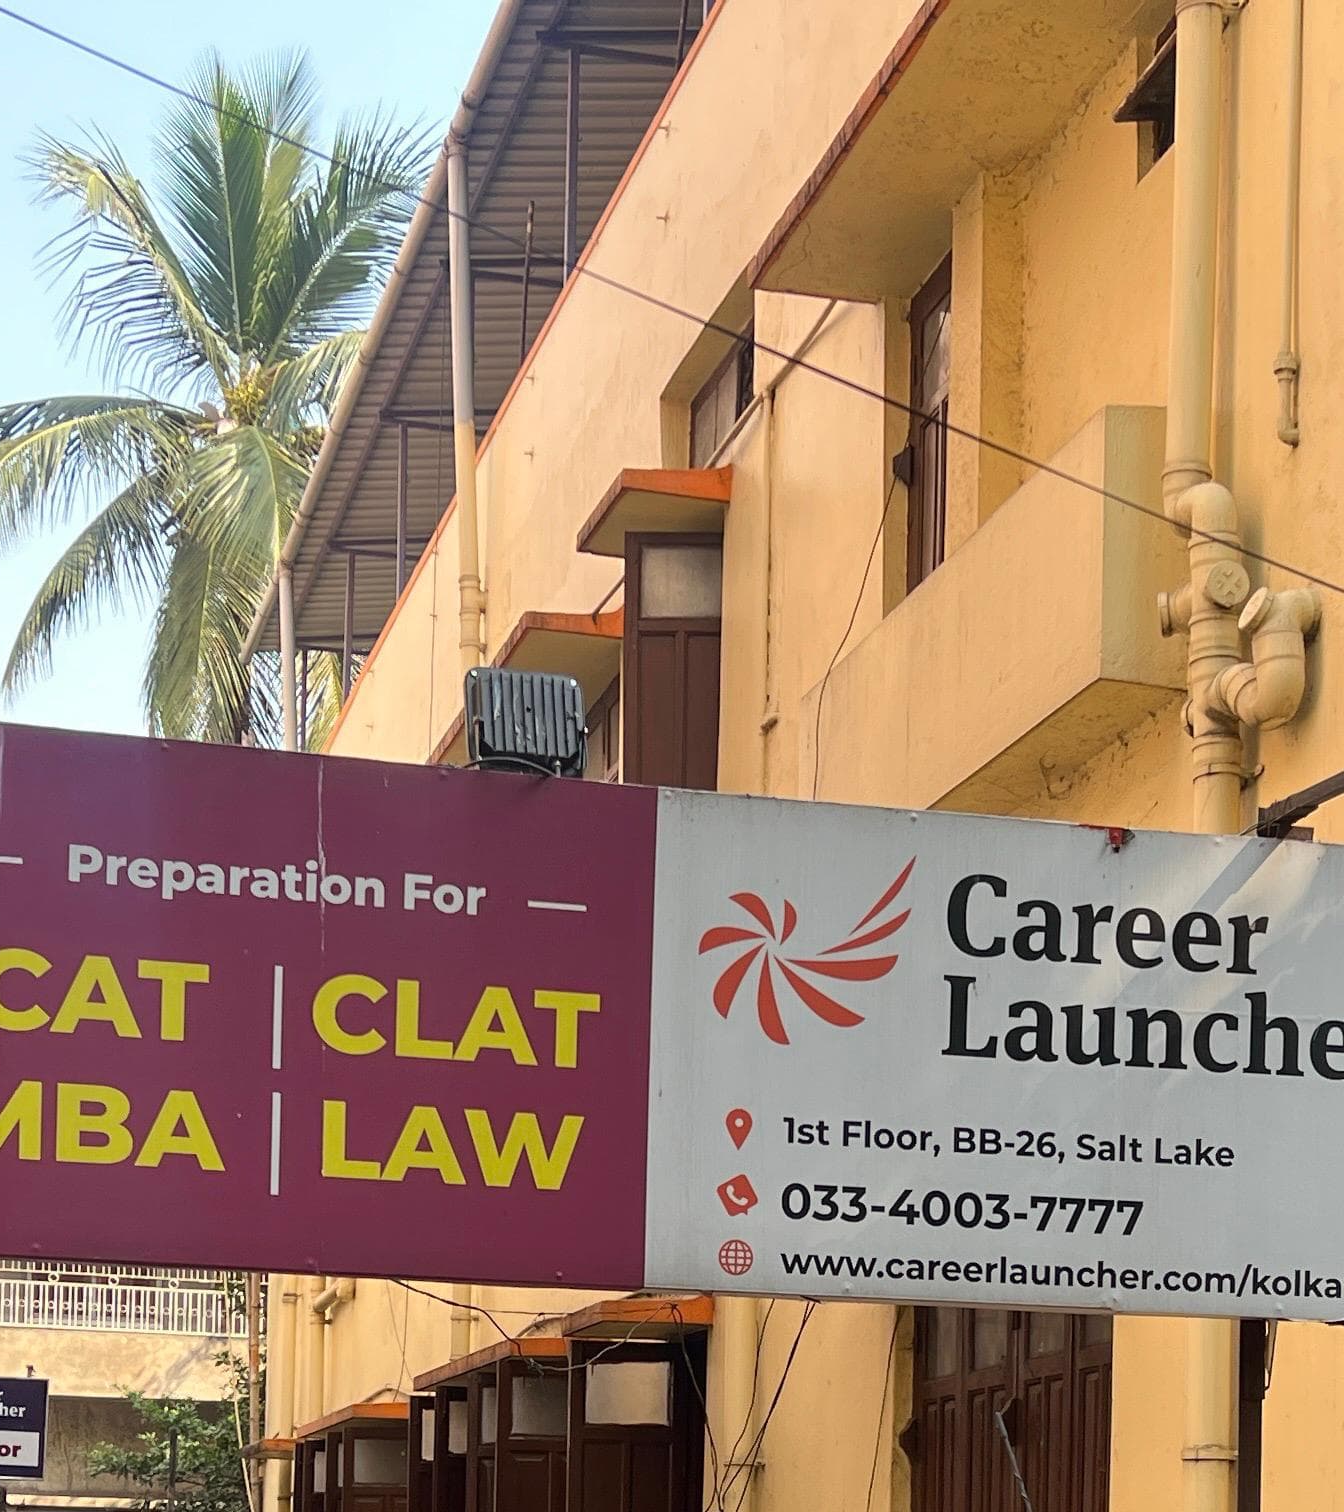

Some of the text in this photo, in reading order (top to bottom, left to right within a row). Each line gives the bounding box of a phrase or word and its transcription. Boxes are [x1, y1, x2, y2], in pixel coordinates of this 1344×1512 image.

[67, 843, 487, 916] Preparation For
[946, 873, 1269, 976] Career
[312, 973, 601, 1069] CLAT
[321, 1099, 585, 1191] LAW
[783, 1116, 1235, 1168] 1st Floor, BB-26, Salt Lake
[781, 1182, 1144, 1237] 033-4003-7777
